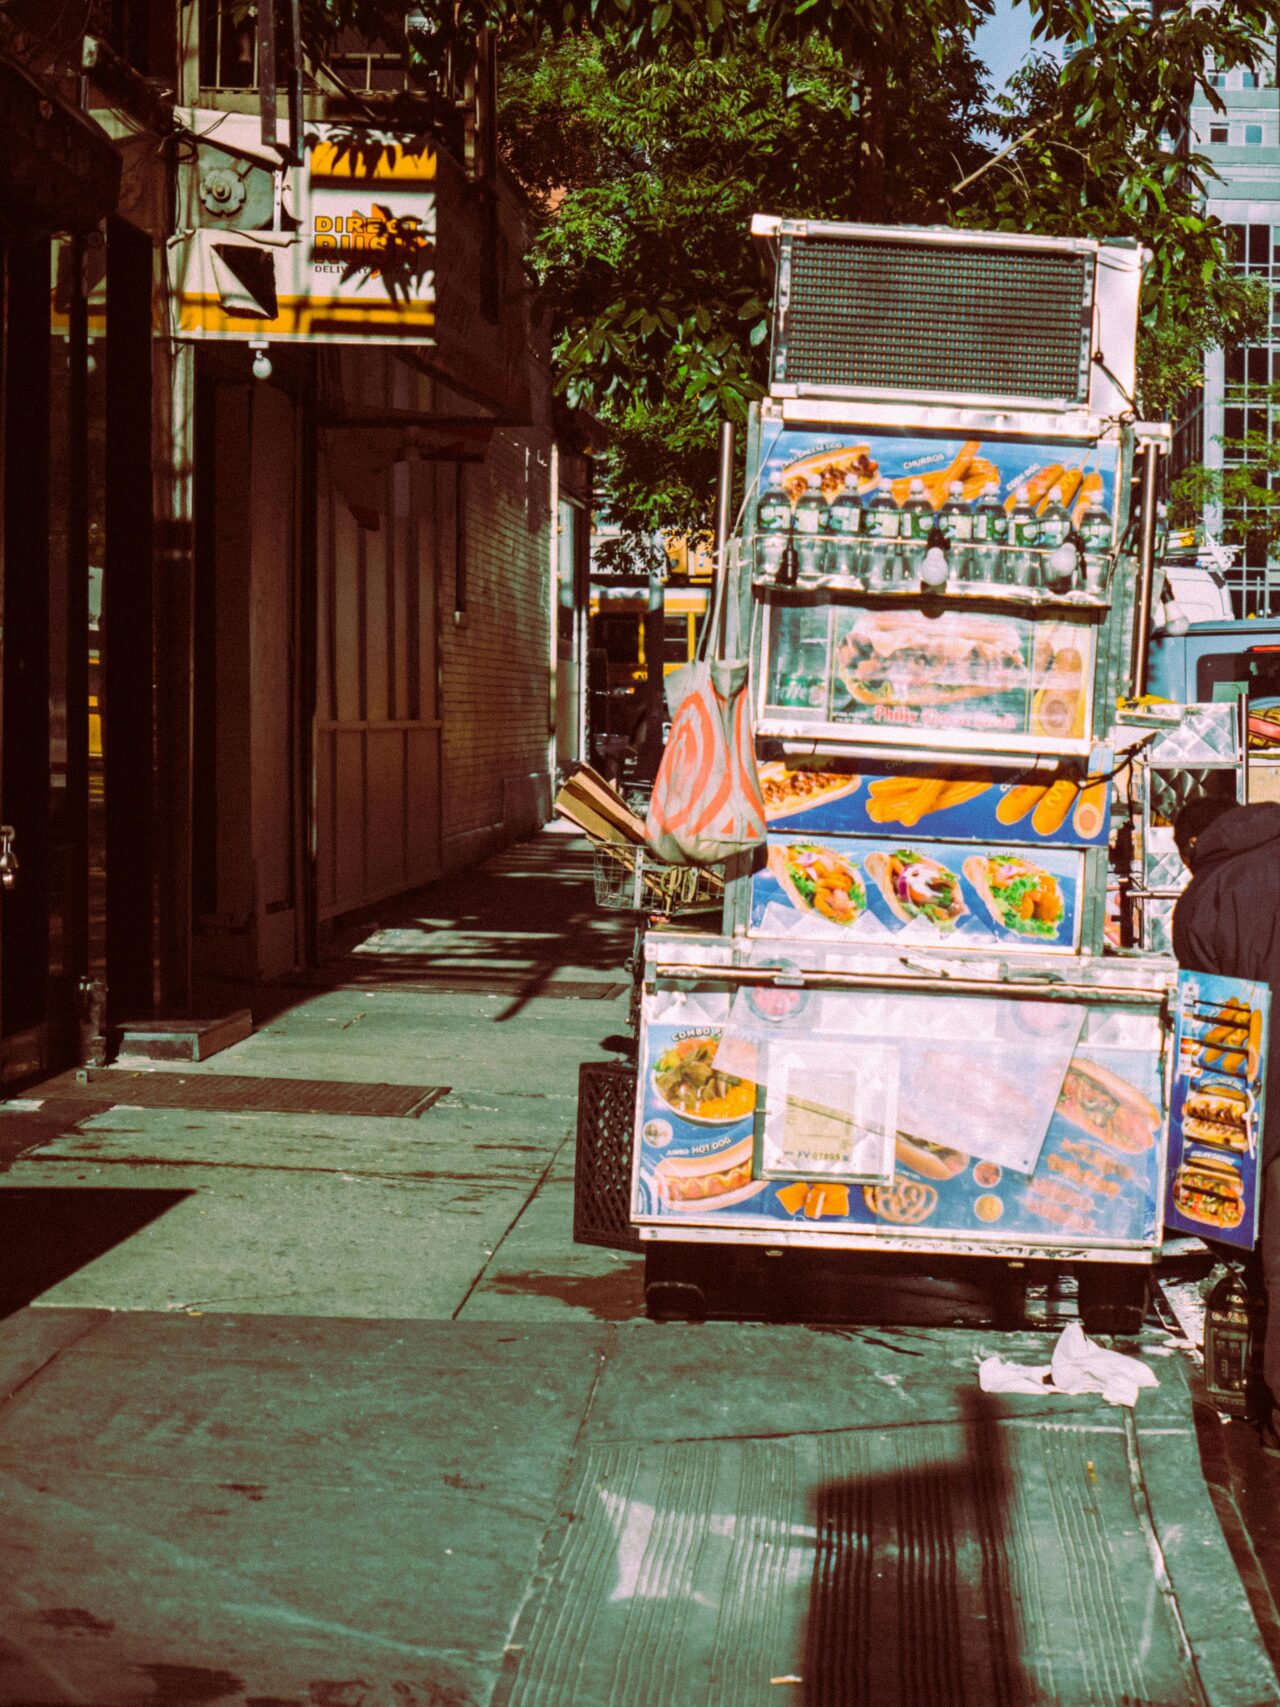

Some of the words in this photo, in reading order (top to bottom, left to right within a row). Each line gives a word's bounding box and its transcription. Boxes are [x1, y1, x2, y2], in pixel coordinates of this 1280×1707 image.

[902, 453, 945, 470] CHURROS
[873, 704, 918, 725] Philly
[671, 1028, 711, 1043] COMBO
[691, 1143, 711, 1155] HOT
[711, 1136, 732, 1150] DOG
